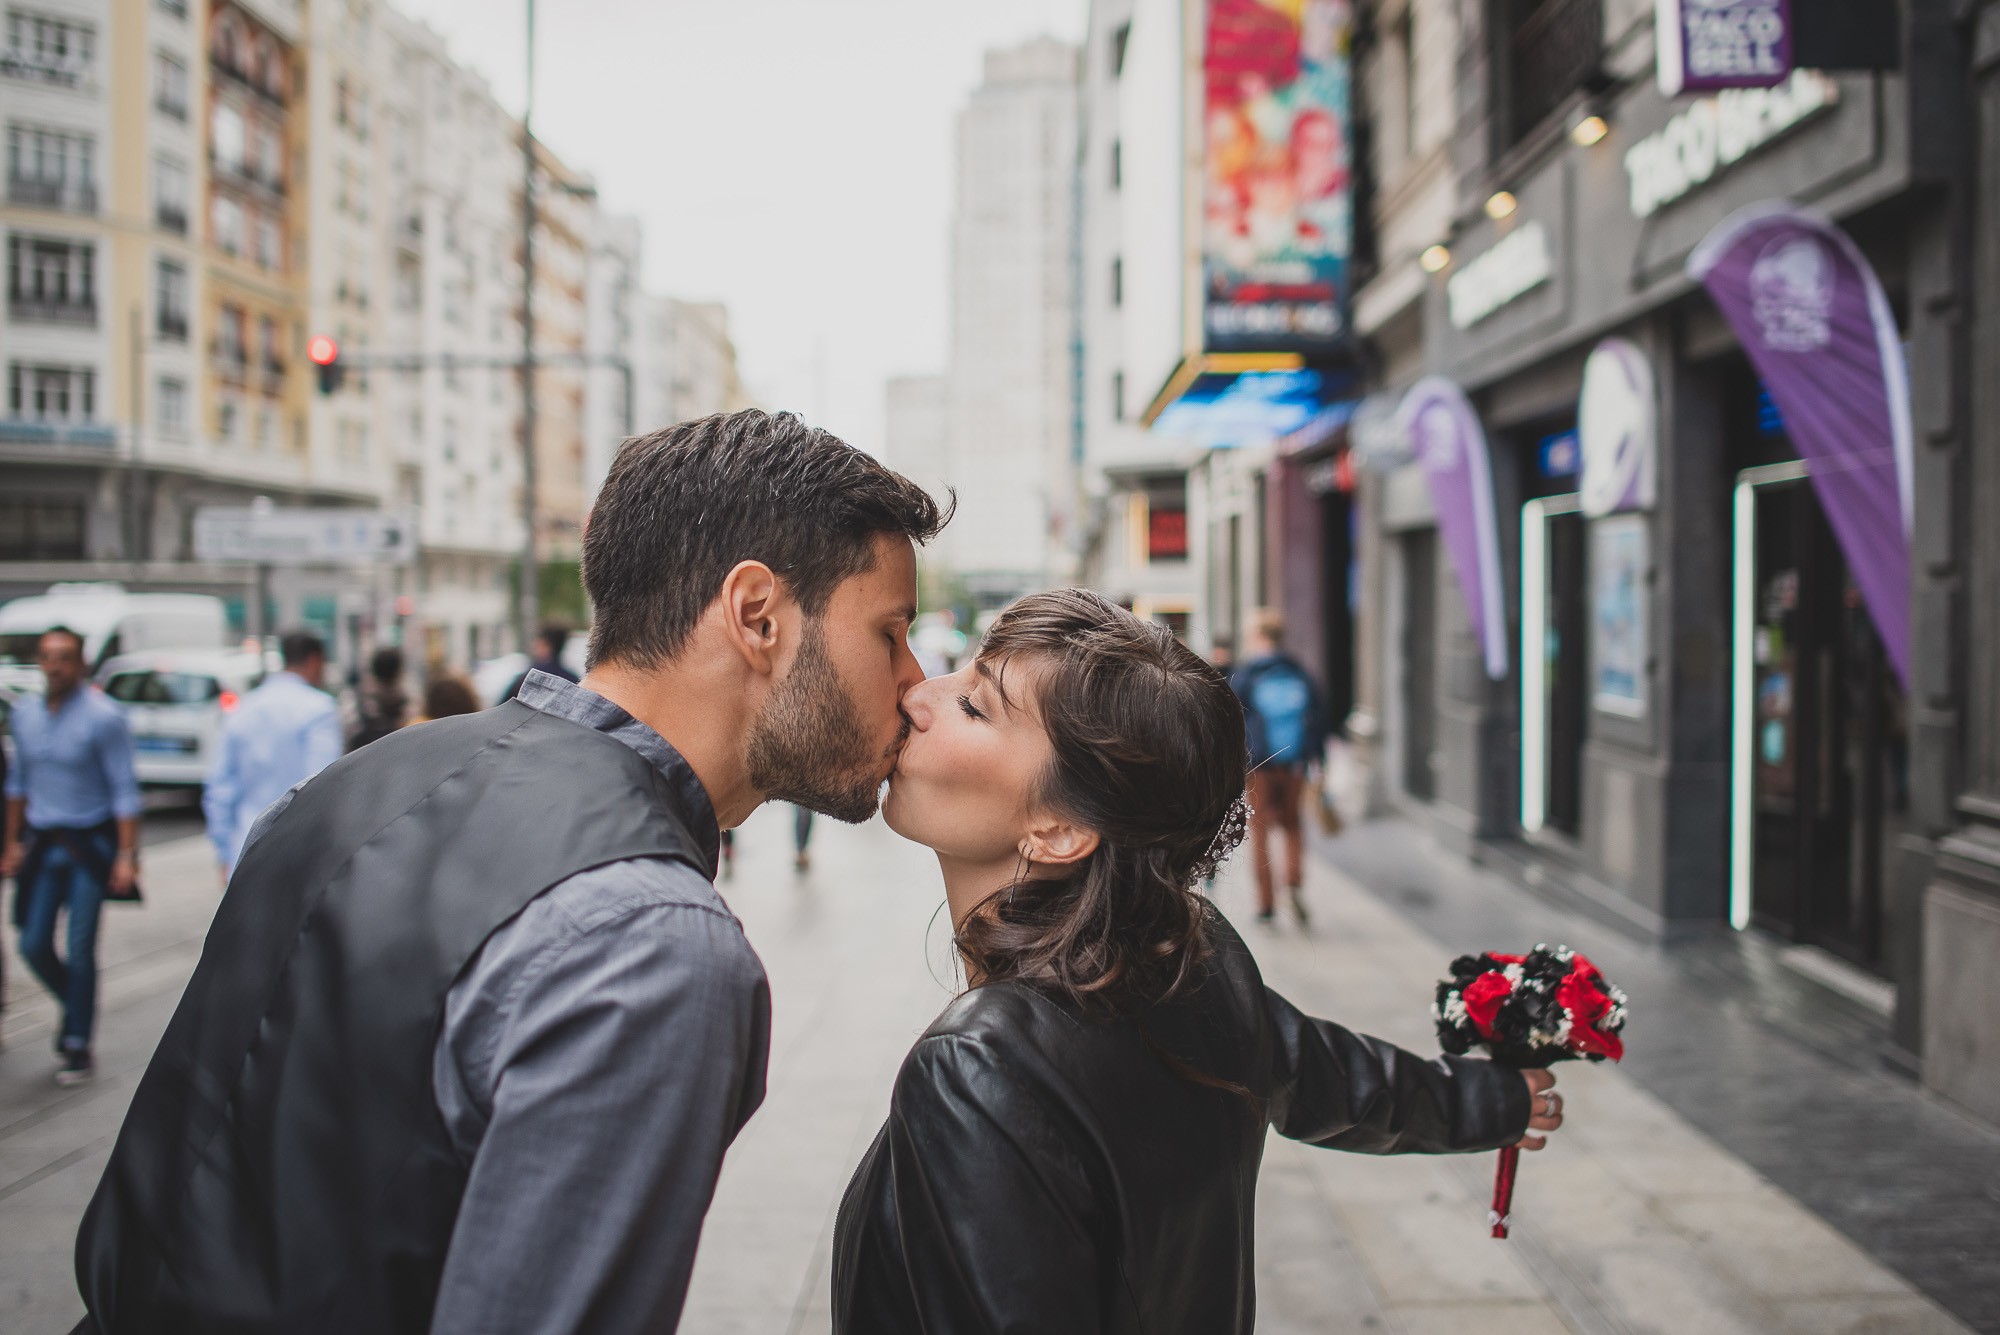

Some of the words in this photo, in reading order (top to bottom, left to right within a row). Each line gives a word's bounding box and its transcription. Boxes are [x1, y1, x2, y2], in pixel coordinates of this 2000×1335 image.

[1685, 7, 1785, 45] TACO
[1688, 44, 1785, 76] BELL
[1625, 98, 1718, 219] TACO
